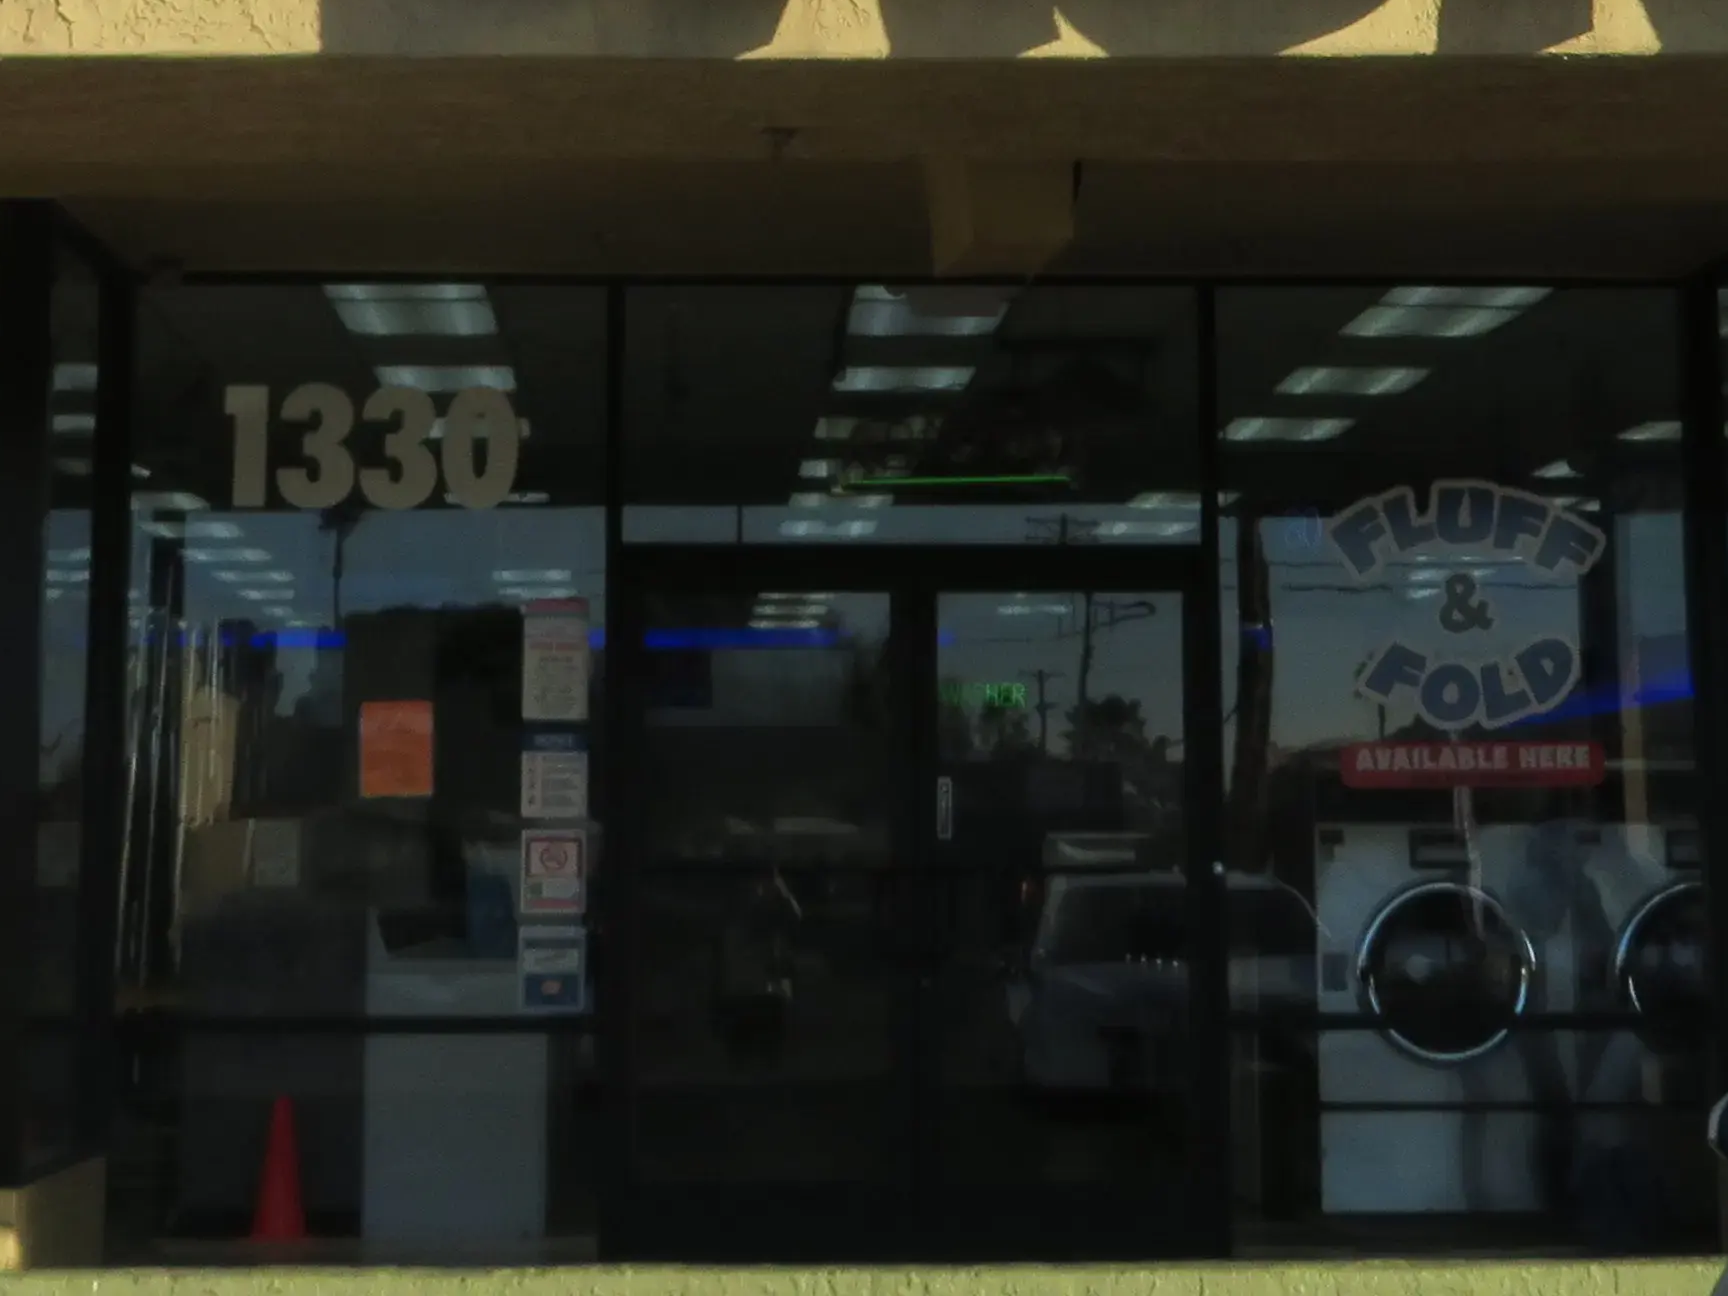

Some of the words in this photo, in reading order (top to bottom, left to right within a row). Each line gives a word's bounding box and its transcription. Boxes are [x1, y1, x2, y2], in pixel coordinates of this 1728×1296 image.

[224, 382, 520, 510] 1330
[1327, 478, 1606, 581] FLUFF
[1438, 573, 1494, 634] &
[1359, 637, 1581, 730] FOLD
[1356, 745, 1509, 771] AVAILABLE
